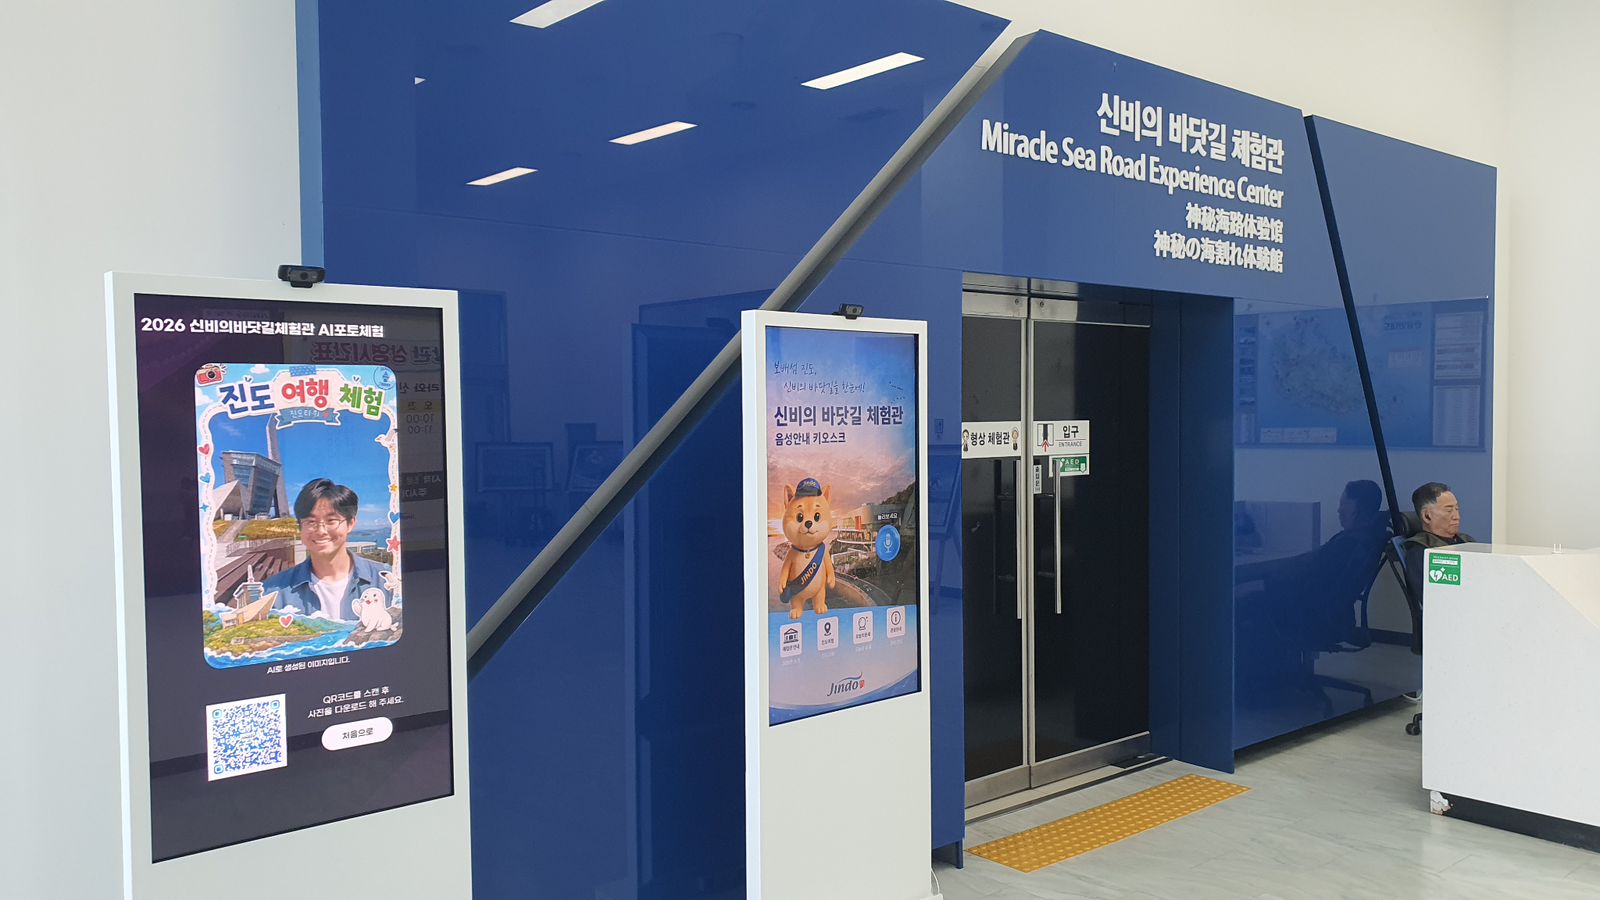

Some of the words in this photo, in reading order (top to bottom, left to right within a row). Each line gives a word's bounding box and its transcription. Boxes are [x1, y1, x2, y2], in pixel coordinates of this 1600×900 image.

[1096, 92, 1162, 147] 신비의
[1168, 112, 1227, 162] 바닷길
[1231, 128, 1285, 174] 체험관
[981, 119, 1058, 164] Miracle
[1061, 137, 1096, 172] Sea
[1100, 145, 1146, 181] Road
[1149, 156, 1235, 199] Experience
[1237, 176, 1284, 208] Center
[1185, 201, 1284, 244] 神秘海路体验馆
[1153, 229, 1284, 273] 神秘の海割れ体験館
[140, 317, 186, 333] 2026
[189, 318, 316, 336] 신비의바닷길체험관
[318, 324, 385, 339] AI포토체험
[800, 363, 818, 376] 진도,
[218, 382, 275, 415] 진도
[281, 377, 329, 408] 여행
[339, 383, 385, 416] 체험
[783, 382, 807, 393] 신비의
[808, 381, 839, 395] 바닷길을
[774, 405, 817, 427] 신비의
[821, 405, 862, 427] 바닷길
[866, 405, 904, 425] 체험관
[775, 432, 811, 446] 음성안내
[812, 432, 846, 445] 키오스크
[987, 431, 1010, 445] 체험관
[1062, 425, 1079, 438] 입구
[800, 561, 818, 585] JINDO
[1441, 573, 1458, 581] AED
[266, 665, 283, 675] AI로
[284, 661, 306, 672] 생성된
[307, 656, 351, 669] 이미지입니다.
[322, 690, 361, 705] QR코드를
[363, 687, 381, 698] 스캔
[381, 686, 390, 696] 후
[826, 679, 859, 697] Jindo
[307, 707, 332, 719] 사진을
[334, 702, 367, 716] 다운로드
[368, 699, 378, 709] 해
[378, 696, 405, 708] 주세요.
[342, 727, 374, 740] 처음으로
